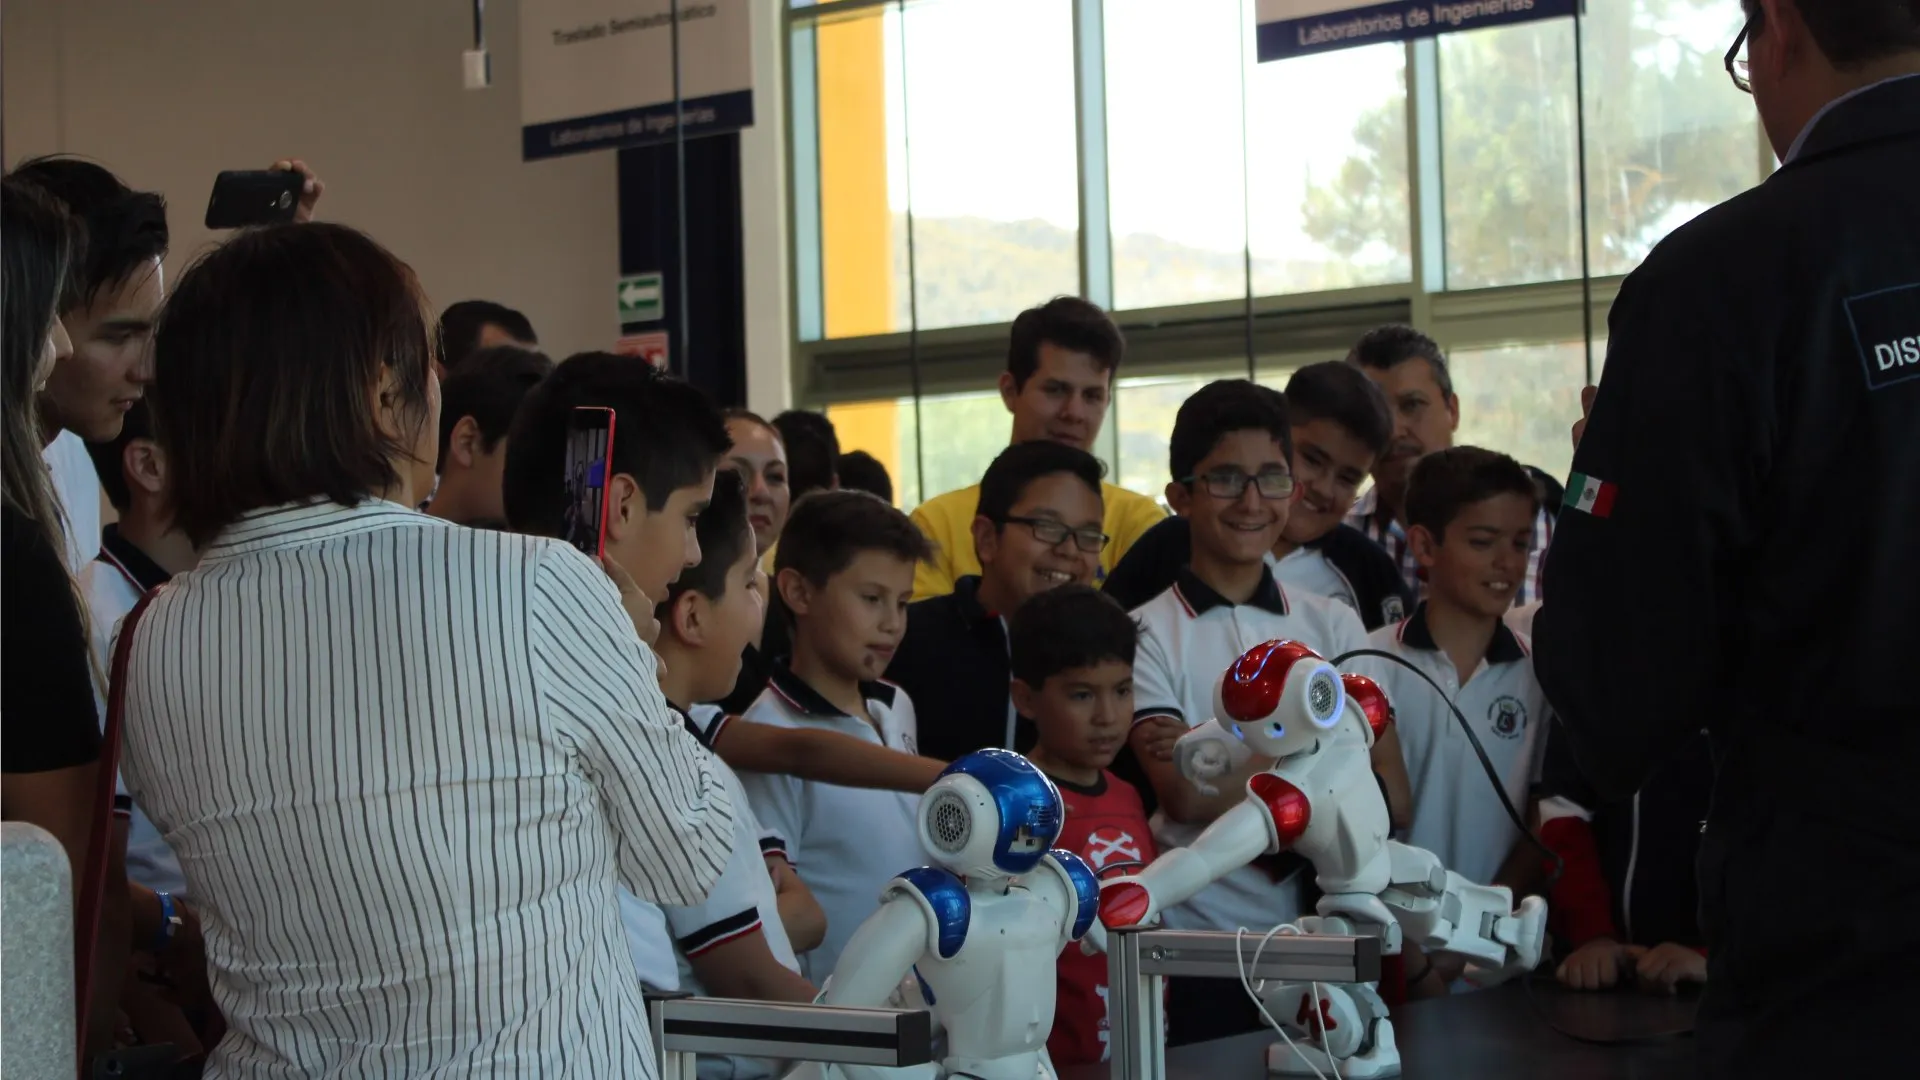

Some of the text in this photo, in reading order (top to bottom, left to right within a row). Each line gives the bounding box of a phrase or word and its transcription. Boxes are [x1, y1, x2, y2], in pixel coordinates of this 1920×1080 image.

[1297, 13, 1403, 46] Laboratorios
[1406, 7, 1429, 28] de
[1874, 335, 1920, 371] DIS
